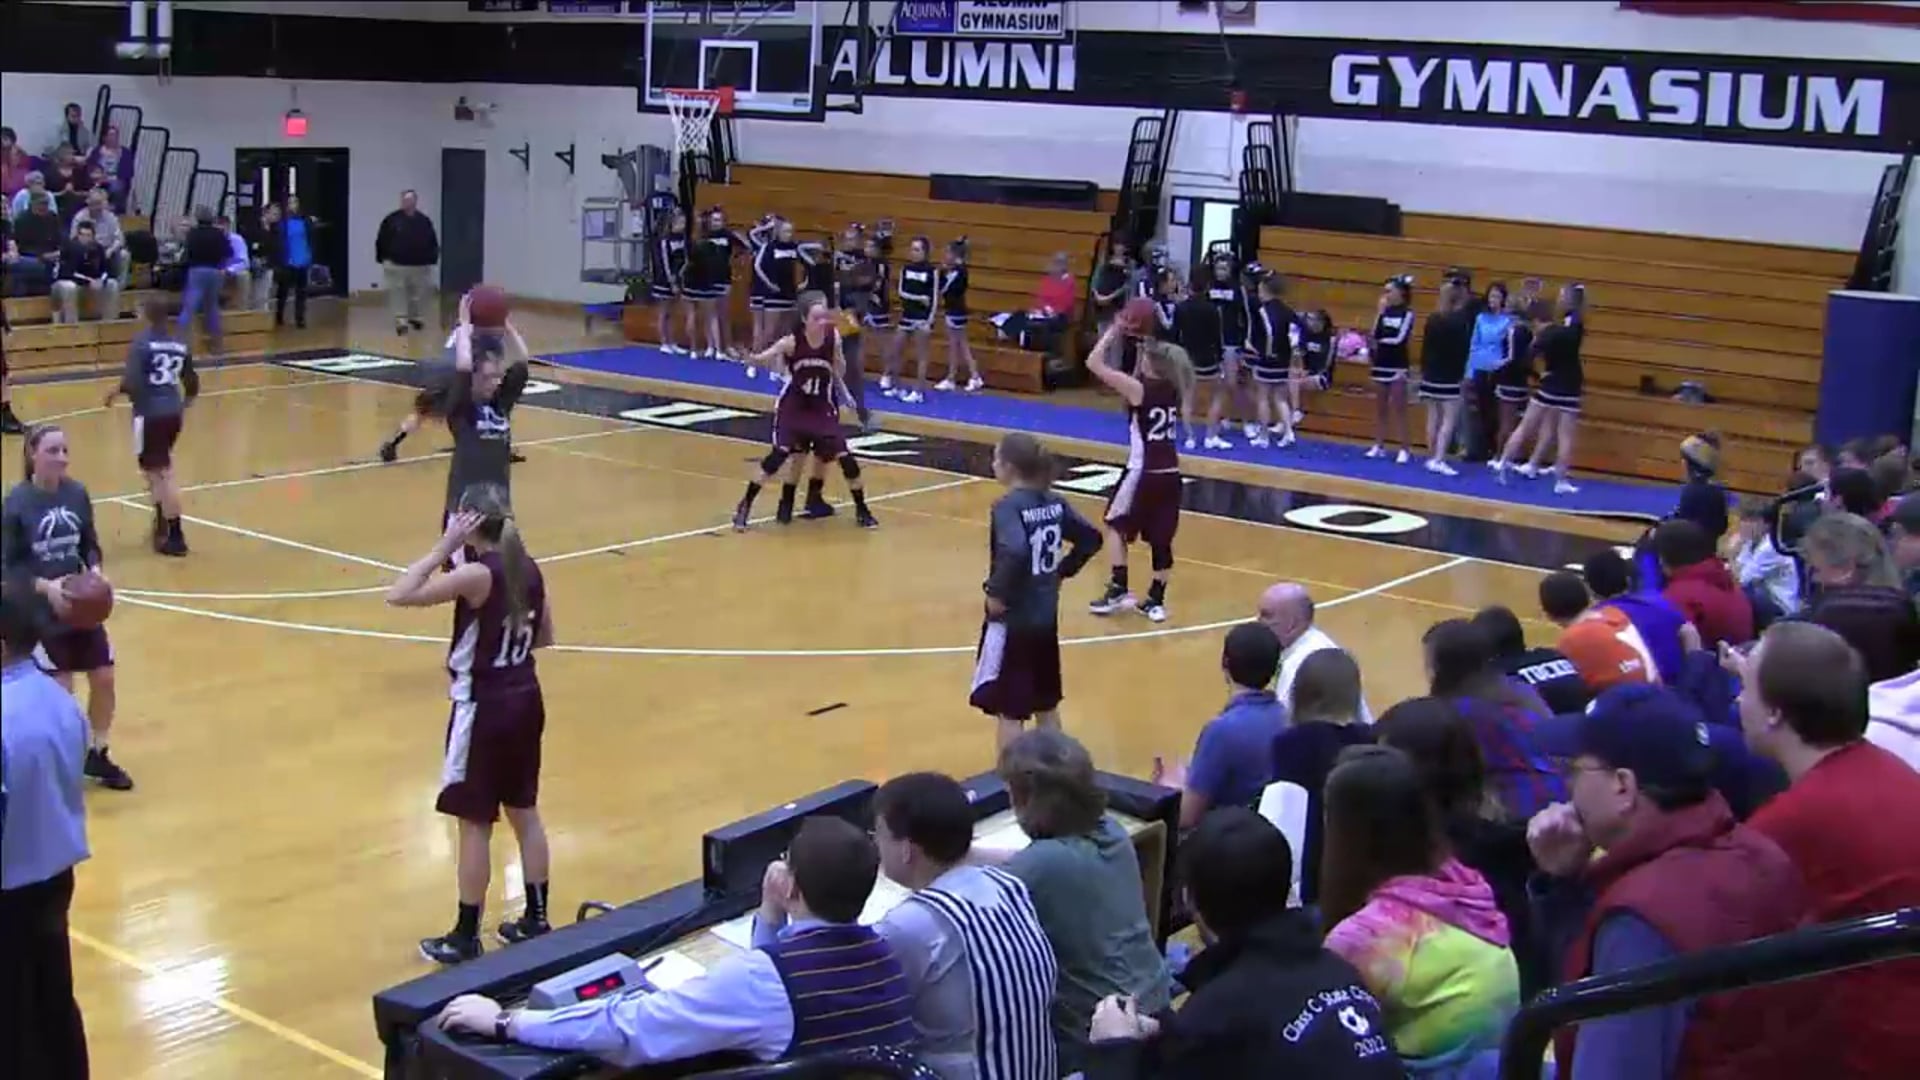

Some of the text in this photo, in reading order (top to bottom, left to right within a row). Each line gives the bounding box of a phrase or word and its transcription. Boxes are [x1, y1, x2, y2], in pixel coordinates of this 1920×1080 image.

[960, 12, 1059, 31] GYMNASIUM
[830, 38, 1885, 136] ALUMNI GYMNASIUM
[801, 376, 820, 396] 41
[1147, 406, 1177, 441] 25
[1029, 523, 1062, 576] 13
[493, 609, 536, 668] 15
[1282, 1008, 1314, 1042] Class
[1307, 998, 1323, 1013] C
[1353, 1035, 1387, 1058] 2012
